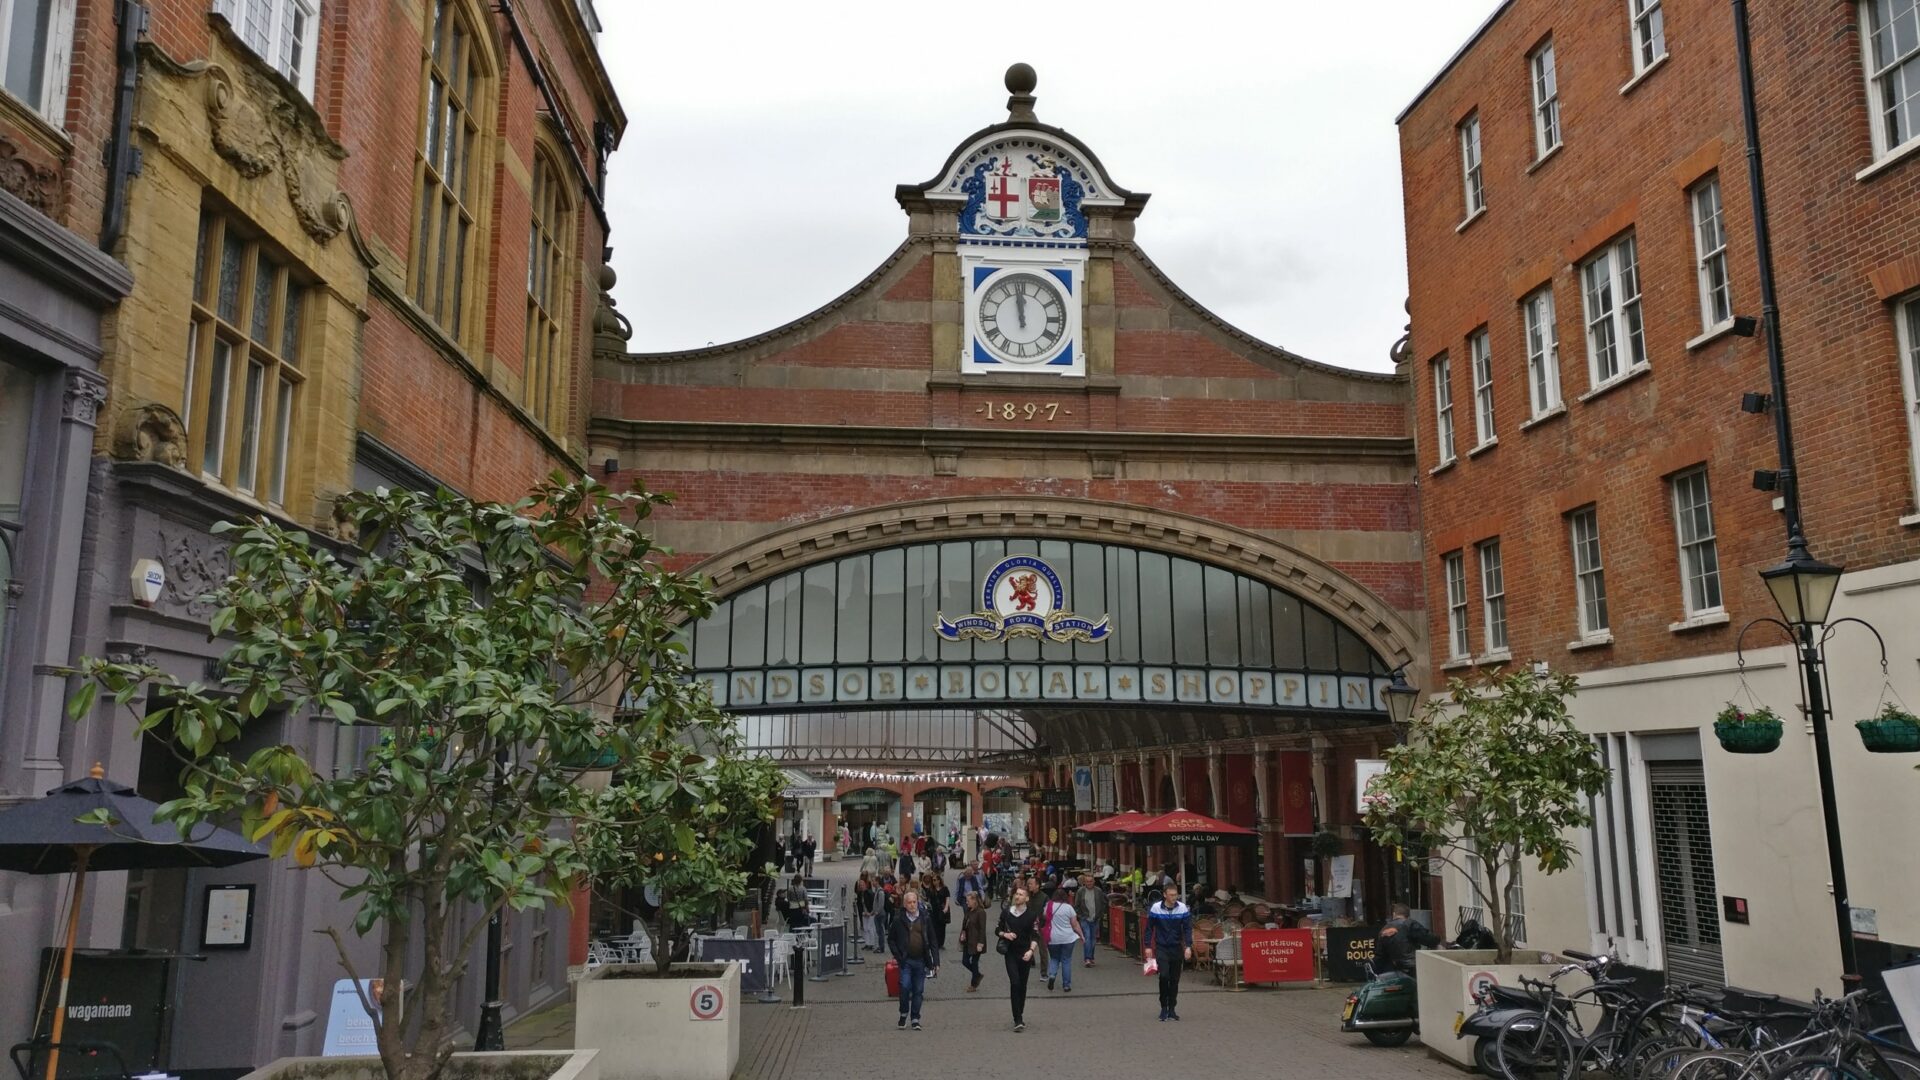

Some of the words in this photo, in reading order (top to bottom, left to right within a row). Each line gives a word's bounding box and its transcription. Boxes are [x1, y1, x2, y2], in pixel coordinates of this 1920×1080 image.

[956, 618, 996, 630] WINDSOR
[1009, 617, 1039, 625] ROYAL
[1054, 621, 1093, 631] STATION
[704, 673, 896, 701] INDSOR
[948, 671, 1100, 694] ROYAL
[1250, 941, 1269, 949] PETIT
[1346, 950, 1376, 961] ROUG
[700, 995, 713, 1011] 5
[68, 1004, 132, 1022] wagamama
